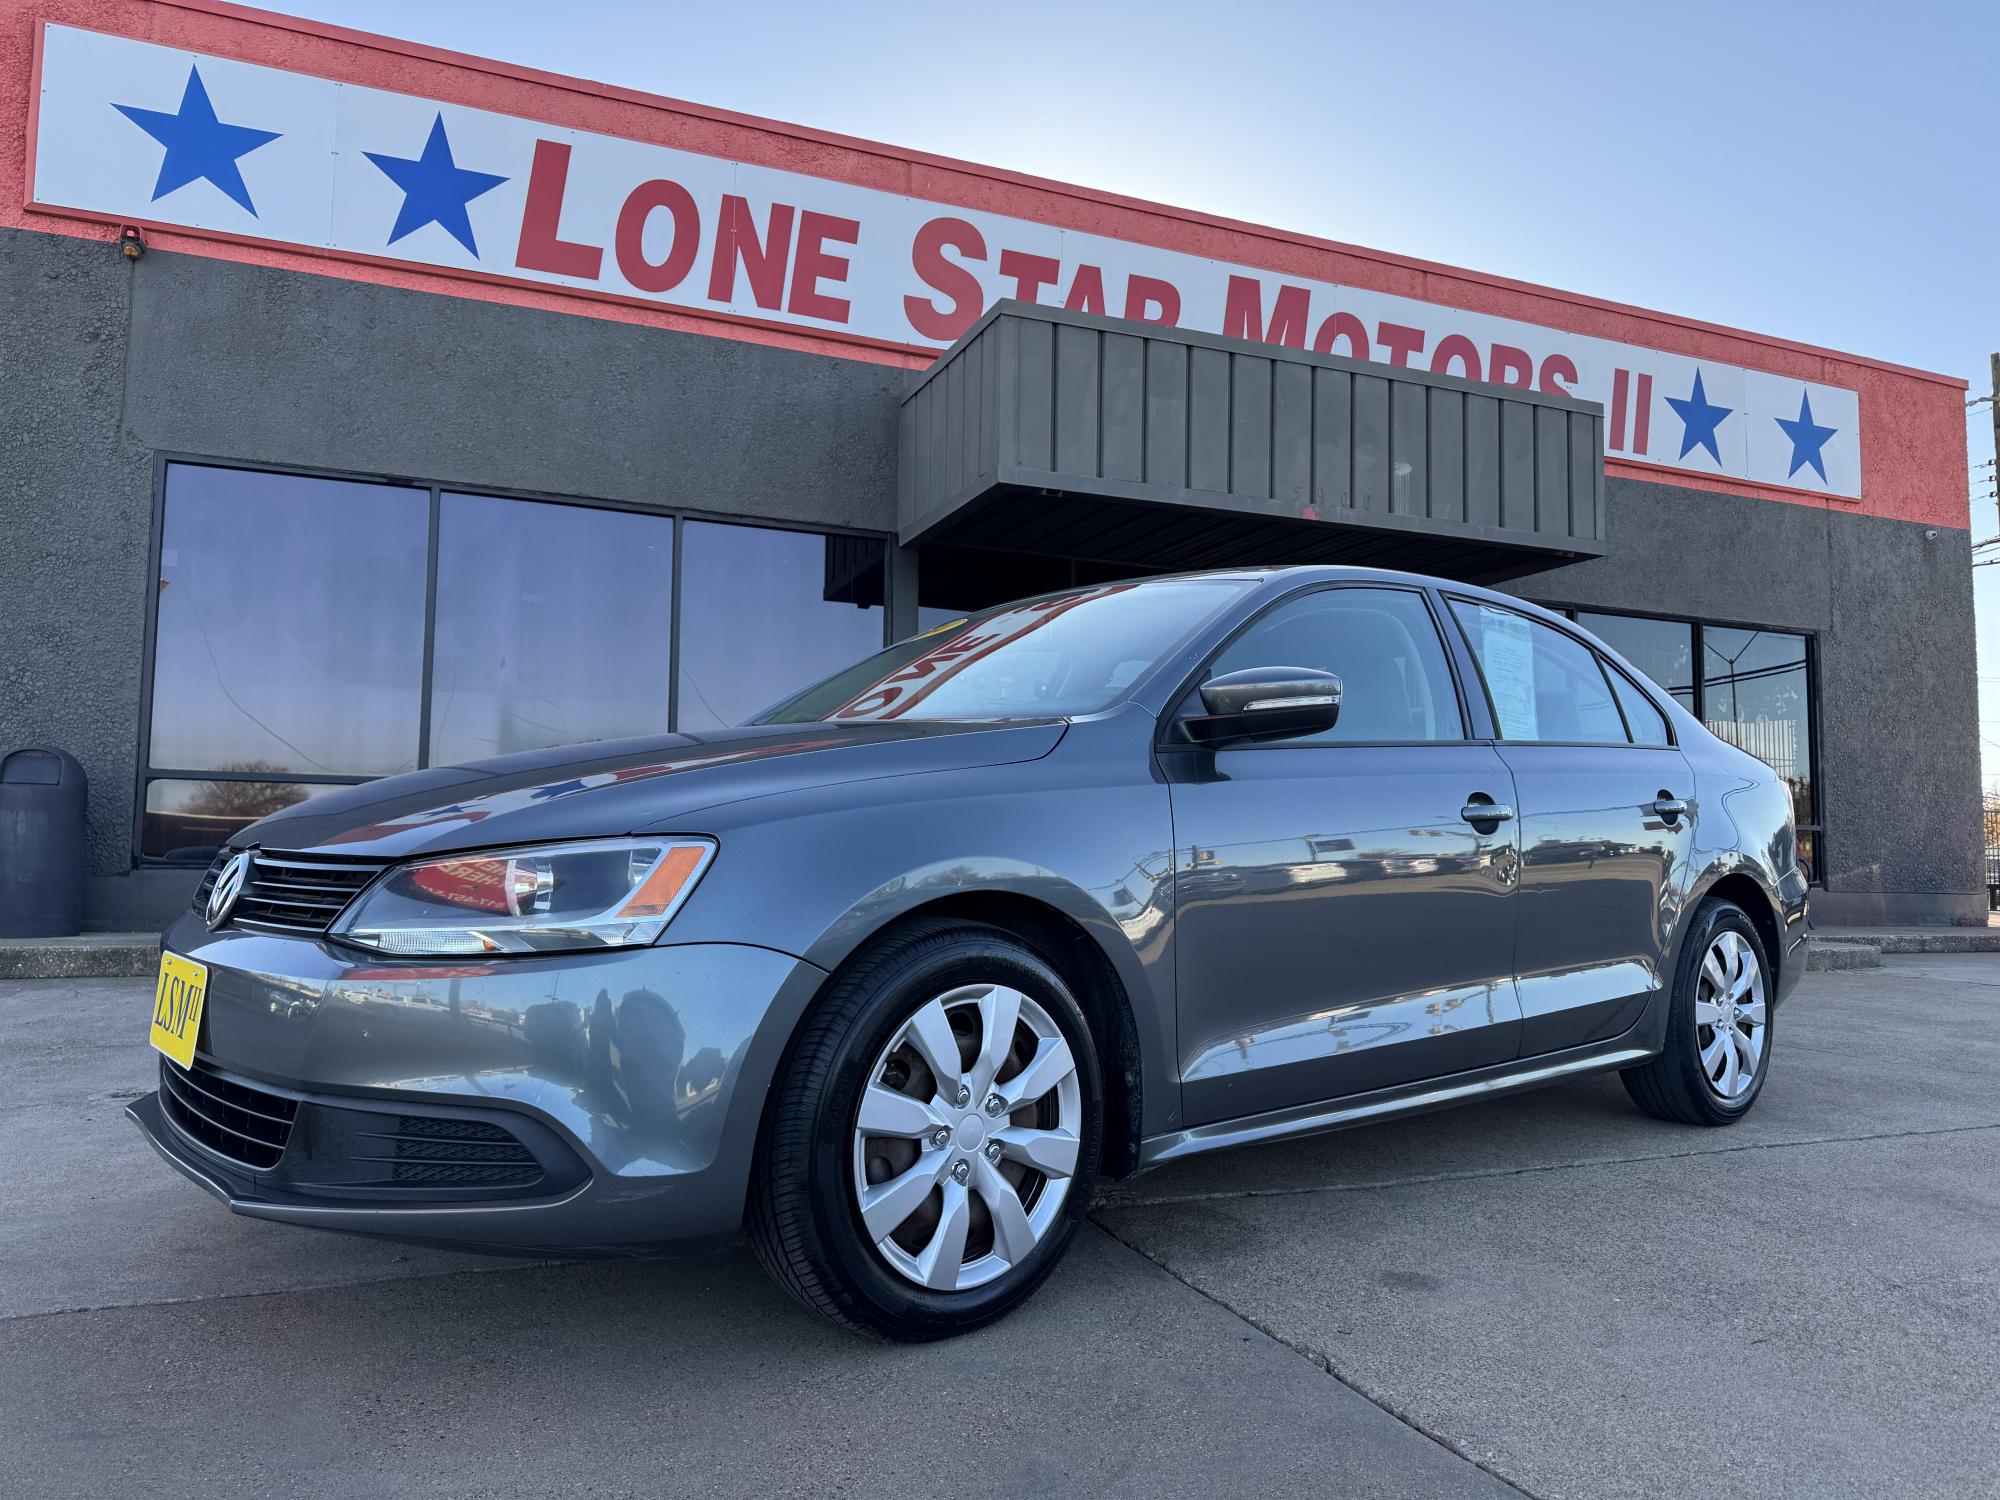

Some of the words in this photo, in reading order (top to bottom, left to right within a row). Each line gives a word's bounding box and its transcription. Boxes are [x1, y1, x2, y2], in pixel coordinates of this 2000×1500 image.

[515, 138, 861, 325] LONE
[903, 216, 1182, 342] STAR
[1608, 367, 1653, 456] II
